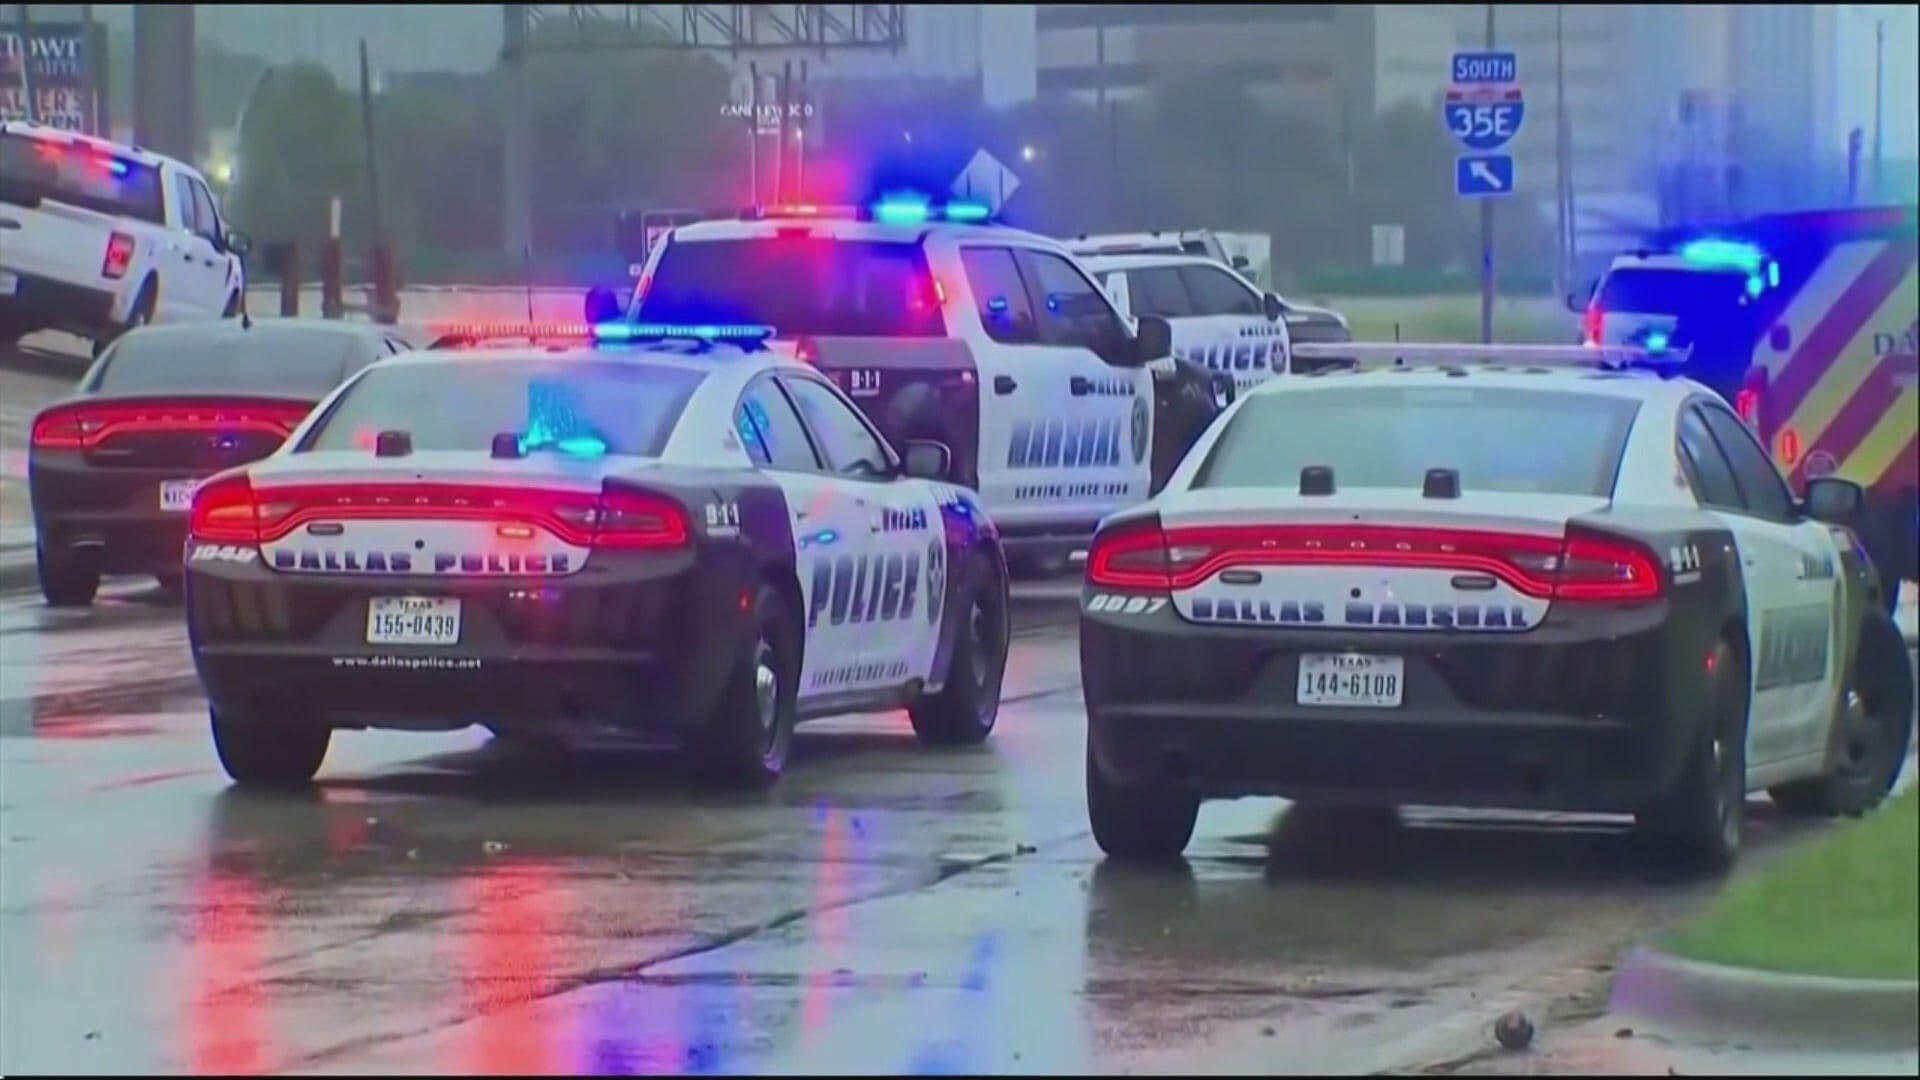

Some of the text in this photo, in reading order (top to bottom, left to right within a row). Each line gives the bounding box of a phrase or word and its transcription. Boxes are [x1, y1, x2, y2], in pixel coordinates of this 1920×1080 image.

[1456, 58, 1513, 80] SOUTH
[1453, 106, 1513, 138] 35E
[275, 550, 569, 573] DALLAS POLICE
[808, 552, 919, 628] POLICE
[375, 614, 454, 636] 155-0439
[1191, 599, 1528, 627] DALLAS MARSHAL
[1333, 655, 1371, 668] TEXAS
[1304, 671, 1397, 697] 144-6108
